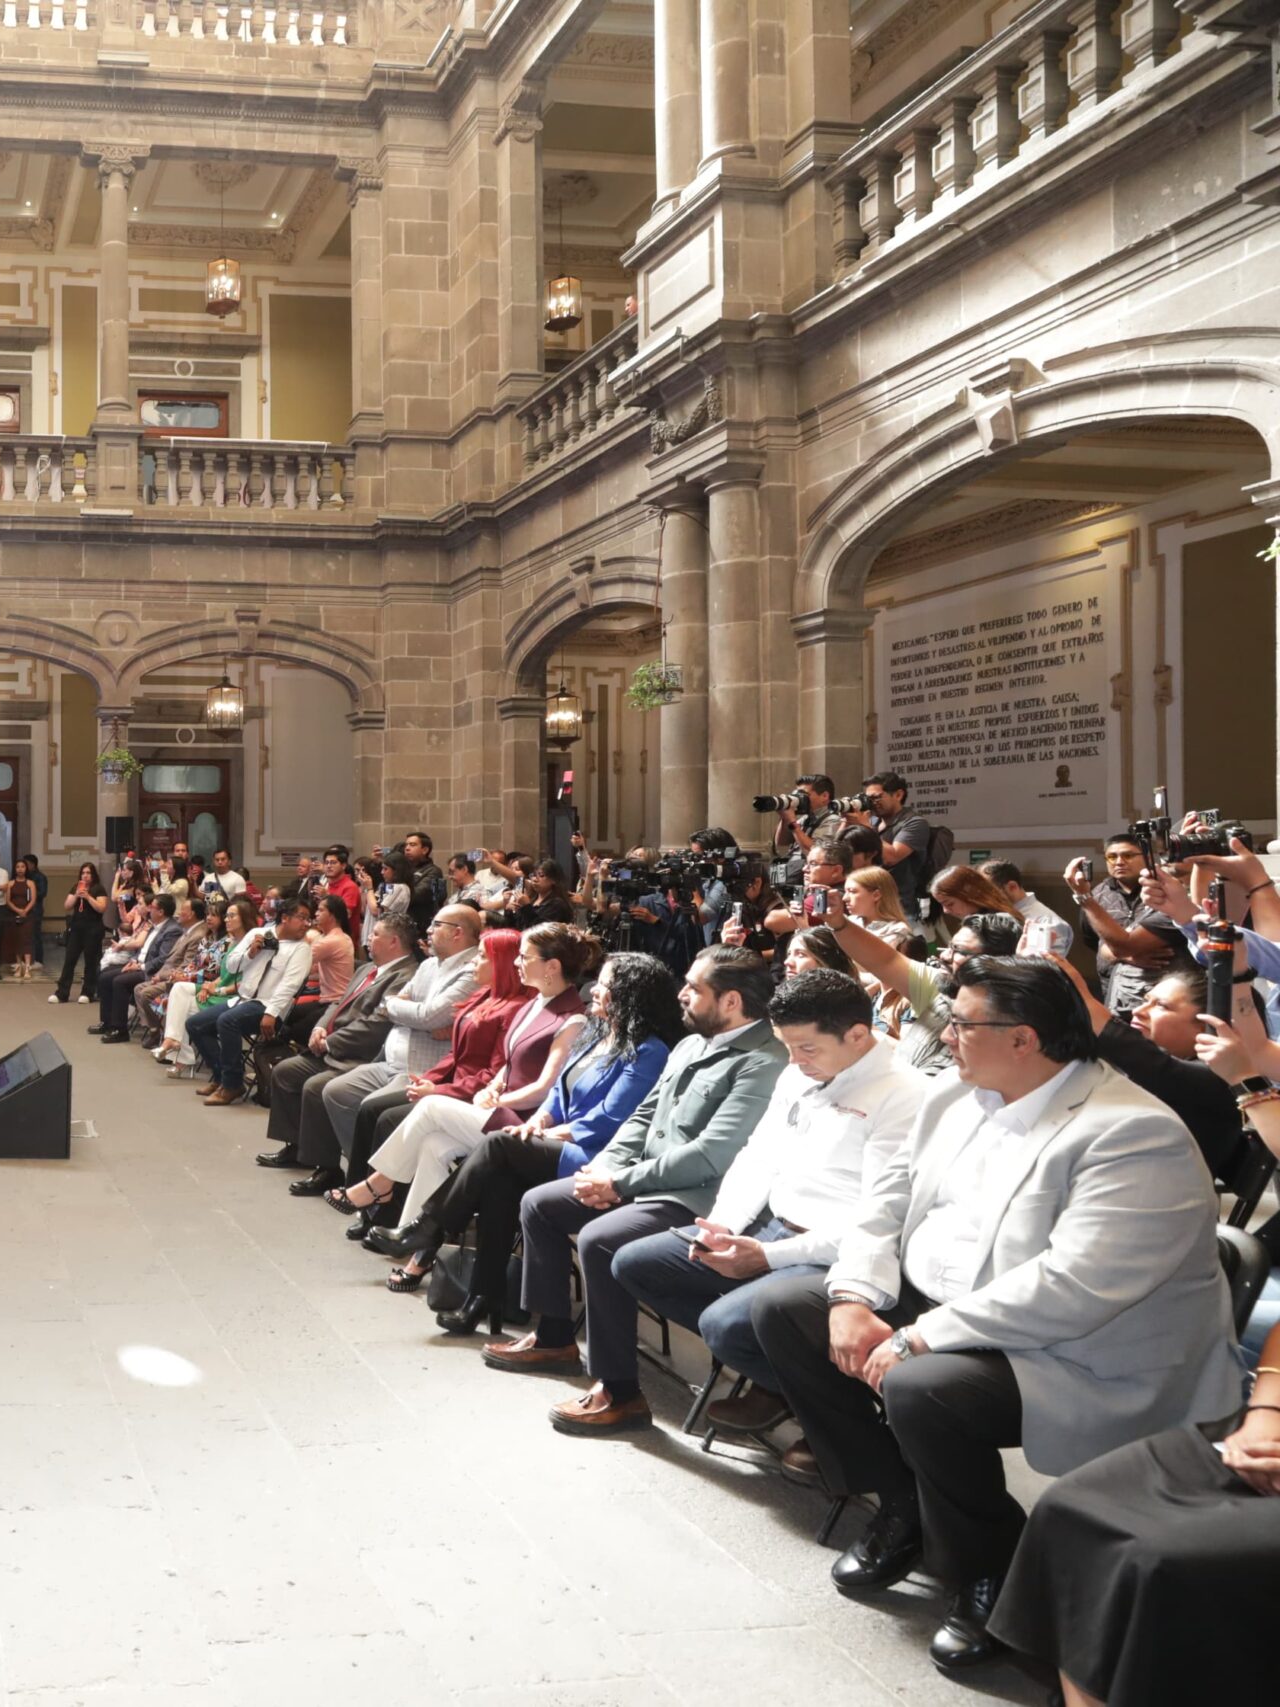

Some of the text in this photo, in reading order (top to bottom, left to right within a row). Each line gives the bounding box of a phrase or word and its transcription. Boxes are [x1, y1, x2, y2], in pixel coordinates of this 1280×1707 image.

[962, 625, 976, 636] QUE
[979, 615, 1023, 632] PREFERIREIS
[1027, 609, 1047, 622] TODO
[1052, 601, 1083, 617] GENERO
[1087, 597, 1098, 610] DE
[939, 642, 976, 657] DESASTRES
[977, 640, 986, 649] AL
[1038, 627, 1048, 637] AL
[1050, 619, 1083, 635] OPROBIO
[1091, 615, 1101, 627] DE
[891, 670, 911, 681] PERDER
[914, 668, 922, 676] LA
[985, 655, 992, 663] DE
[997, 646, 1038, 661] CONSENTIR
[1042, 643, 1056, 653] QUE
[977, 666, 1011, 679] NUESTRAS
[1014, 656, 1065, 673] INSTITUCIONES
[927, 693, 936, 701] EN
[940, 688, 969, 699] NUESTRO
[974, 682, 1003, 694] REGIMEN
[1009, 674, 1048, 688] INTERIOR.
[926, 726, 934, 734] FE
[937, 725, 945, 733] EN
[947, 720, 980, 732] NUESTROS
[984, 716, 1012, 727] PROPIOS
[1017, 709, 1059, 722] ESFUERZOS
[1070, 704, 1099, 715] UNIDOS
[935, 713, 941, 721] FE
[945, 711, 954, 719] EN
[956, 709, 966, 718] LA
[969, 705, 997, 716] JUSTICIA
[1001, 703, 1010, 712] DE
[1014, 698, 1046, 710] NUESTRA
[918, 750, 945, 760] NUESTRA
[984, 744, 993, 752] NO
[998, 742, 1011, 751] LOS
[1014, 737, 1056, 749] PRINCIPIOS
[1059, 736, 1069, 745] DE
[1071, 732, 1105, 743] RESPETO
[926, 739, 933, 747] LA
[935, 733, 985, 746] INDEPENDENCIA
[988, 731, 996, 739] DE
[1000, 727, 1028, 738] MEXICO
[1030, 722, 1067, 734] HACIENDO
[1068, 717, 1106, 730] TRIUNFAR
[971, 759, 980, 767] LA
[983, 754, 1025, 765] SOBERANIA
[1027, 753, 1036, 761] DE
[1039, 751, 1054, 760] LAS
